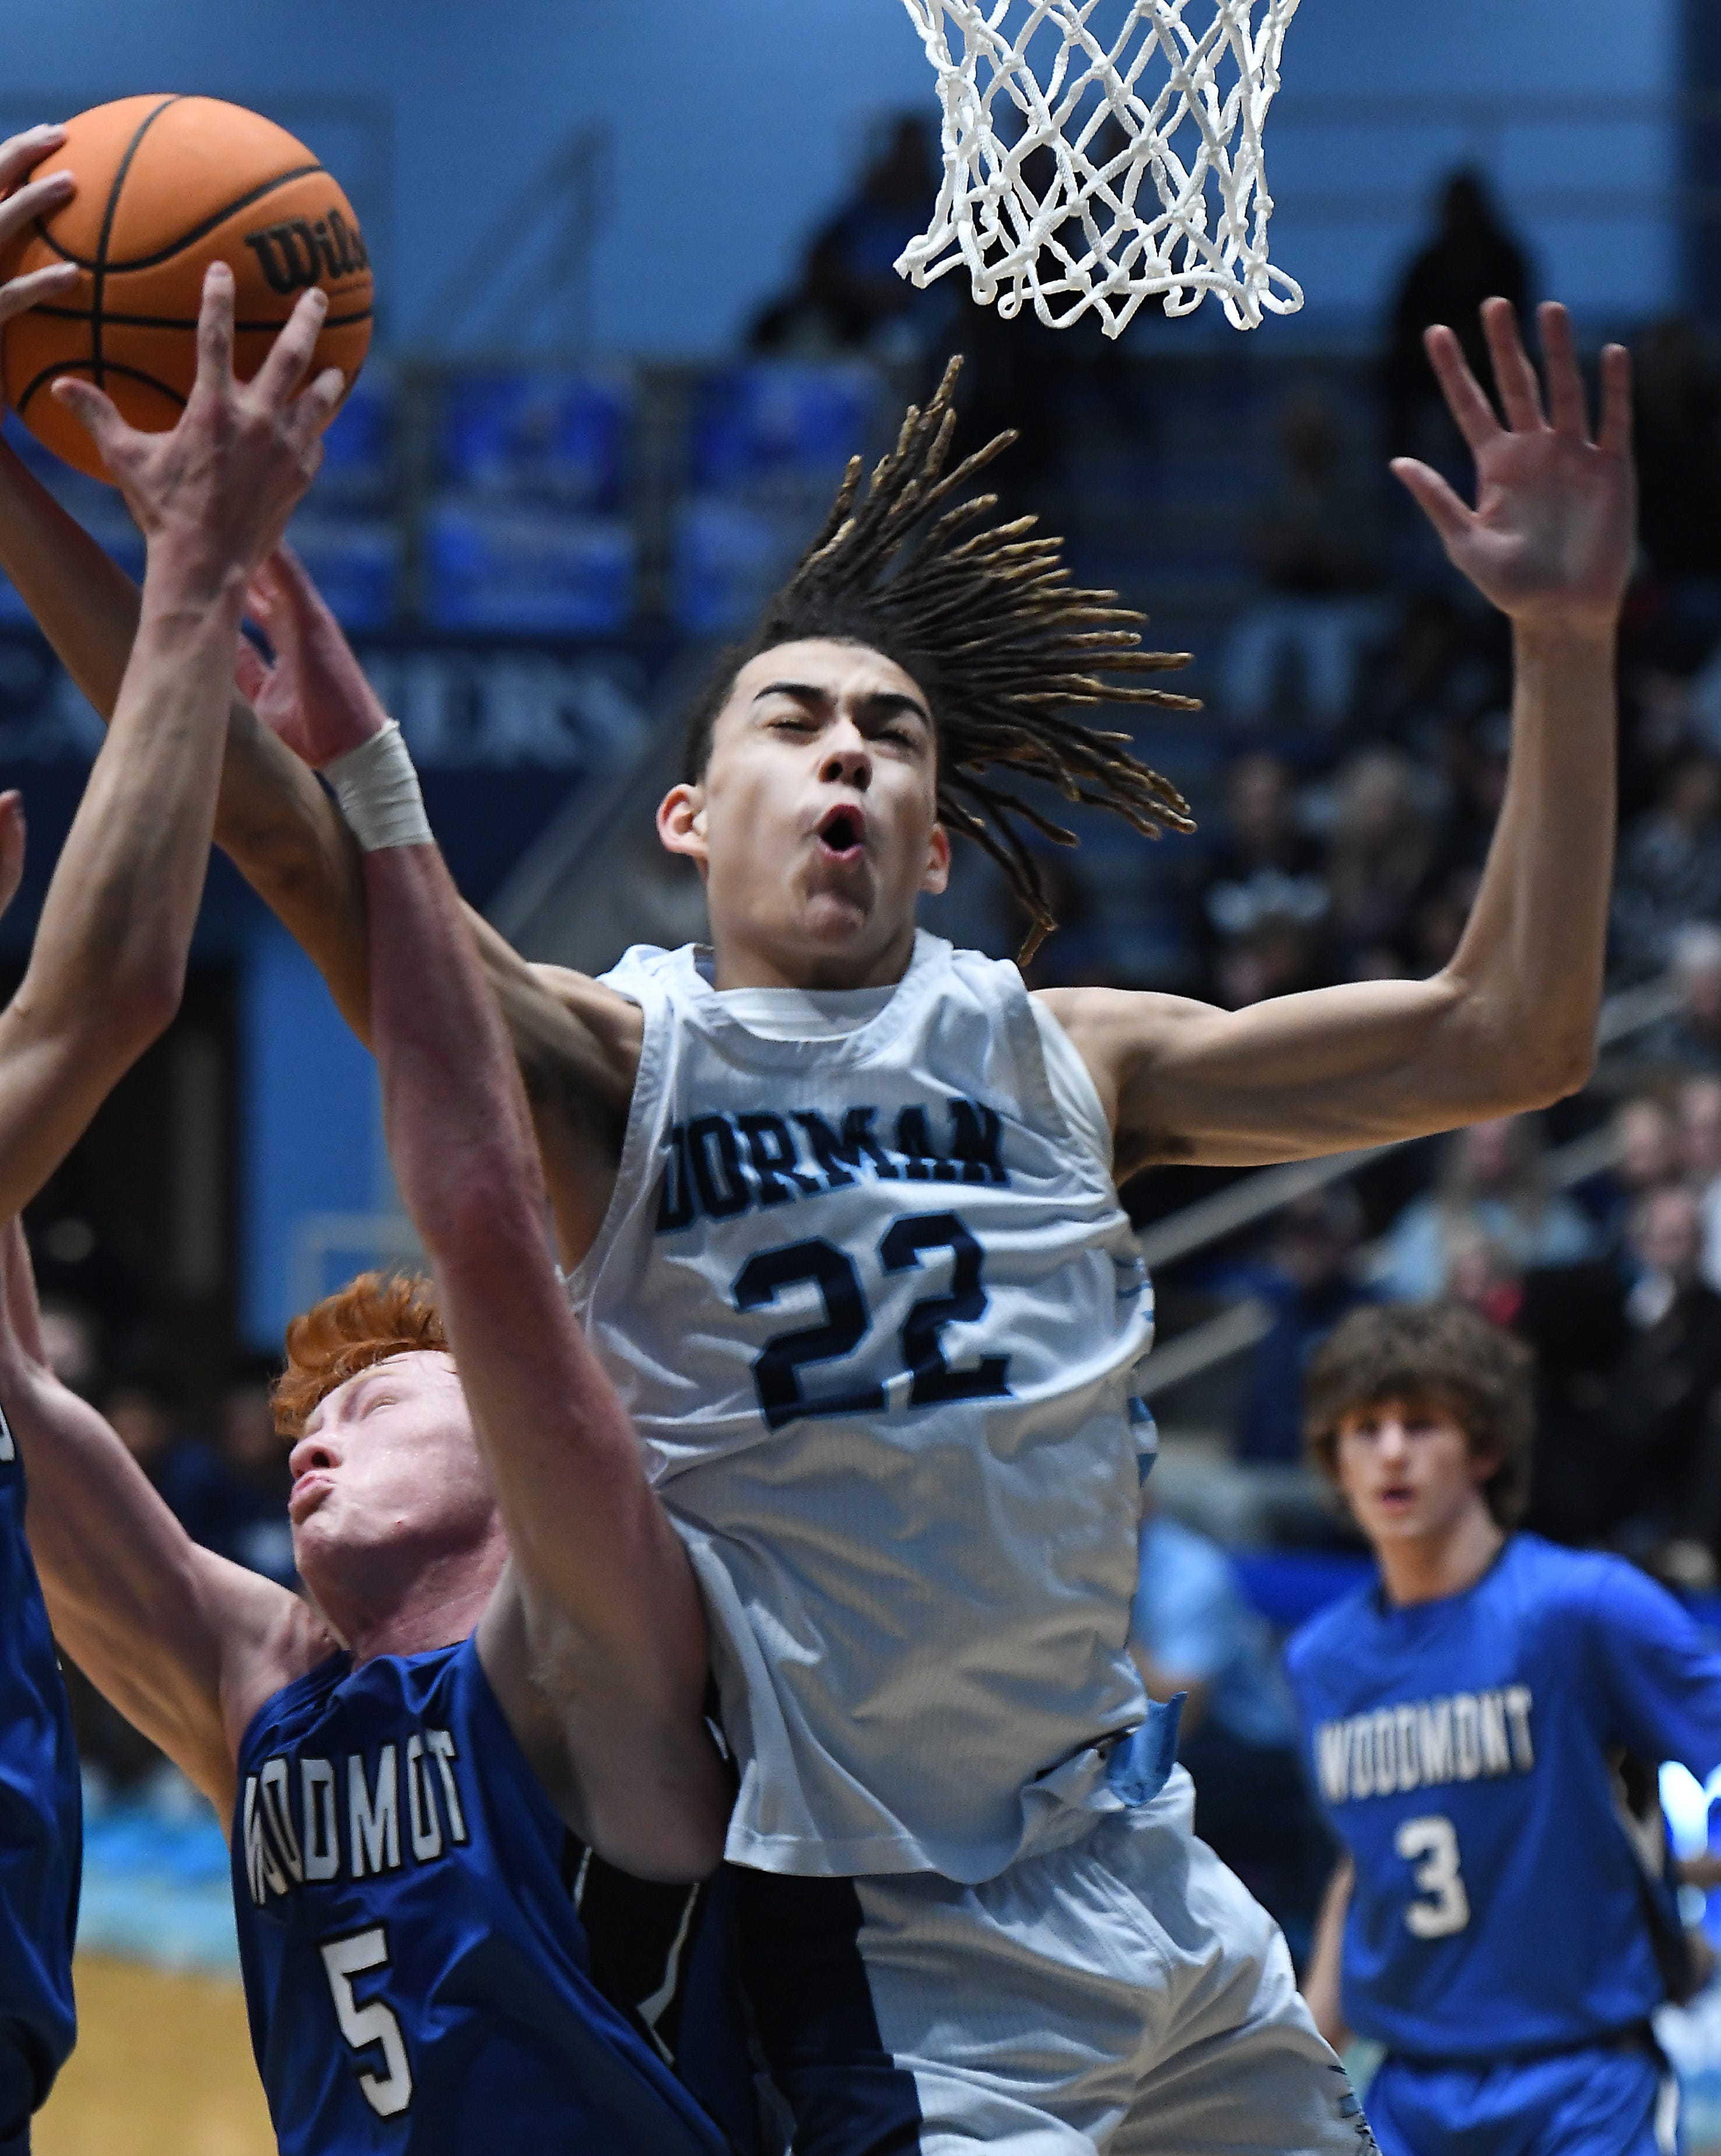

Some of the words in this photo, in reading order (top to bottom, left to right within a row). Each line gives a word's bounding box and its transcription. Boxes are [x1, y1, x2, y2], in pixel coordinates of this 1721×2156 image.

[732, 1209, 1013, 1430] 22
[1317, 1686, 1533, 1803] WOODMONT
[1396, 1816, 1469, 1937] 3
[321, 1927, 413, 2118] 5
